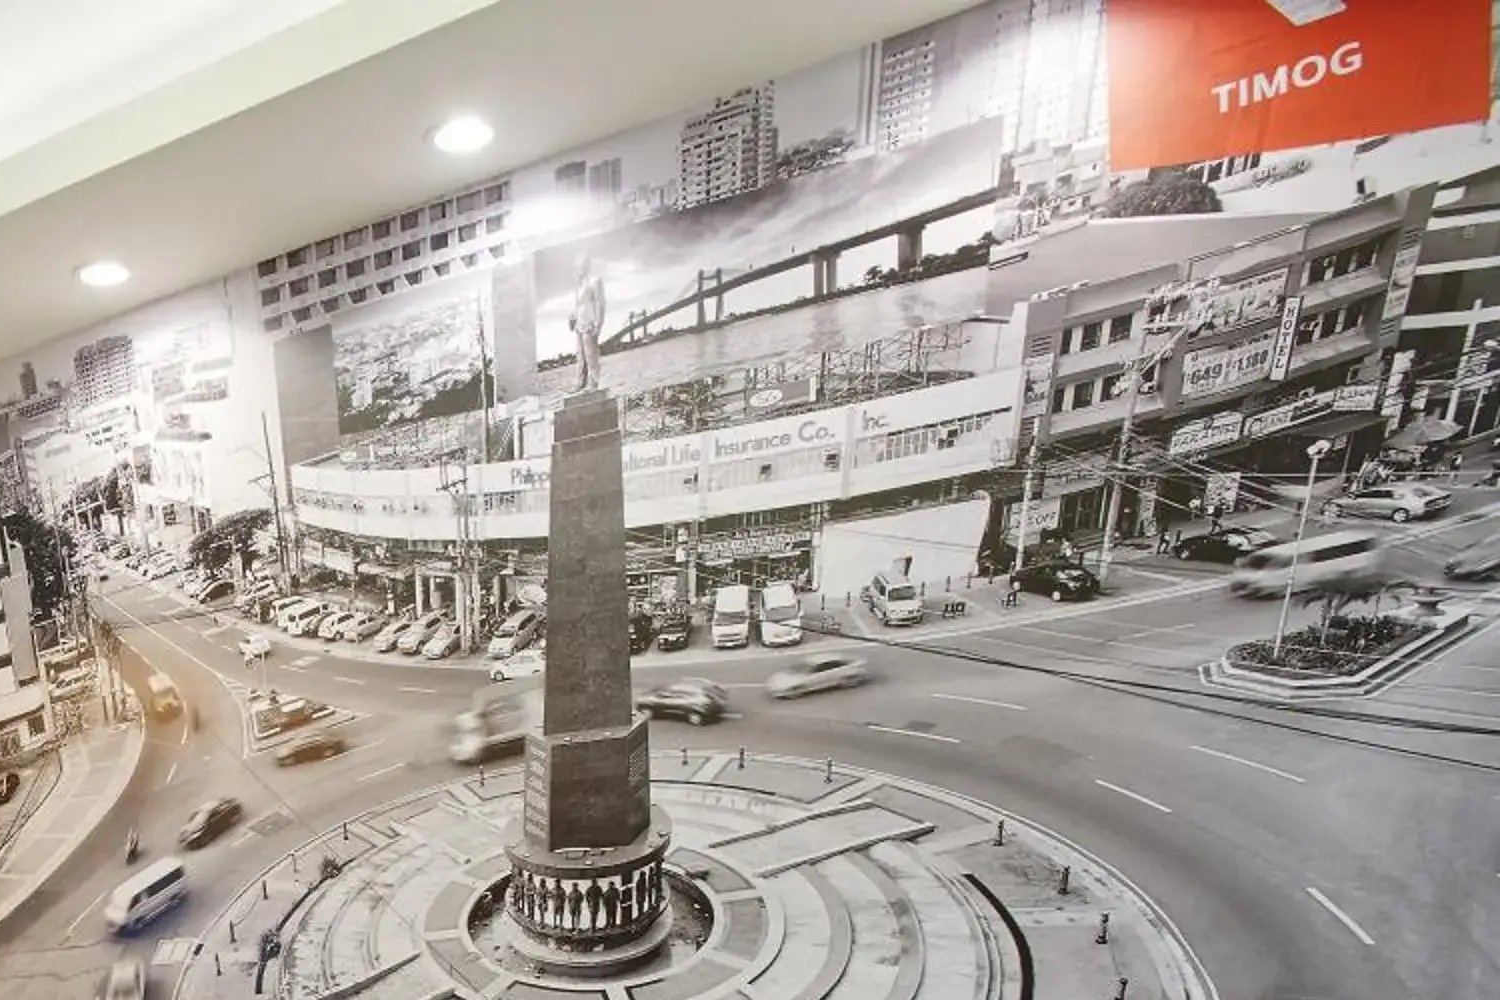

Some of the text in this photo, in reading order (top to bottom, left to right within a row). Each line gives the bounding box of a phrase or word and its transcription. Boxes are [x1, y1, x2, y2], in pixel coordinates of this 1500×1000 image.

[1211, 41, 1363, 114] TIMOG
[1275, 306, 1297, 369] HOTEL
[715, 433, 792, 458] Insurance
